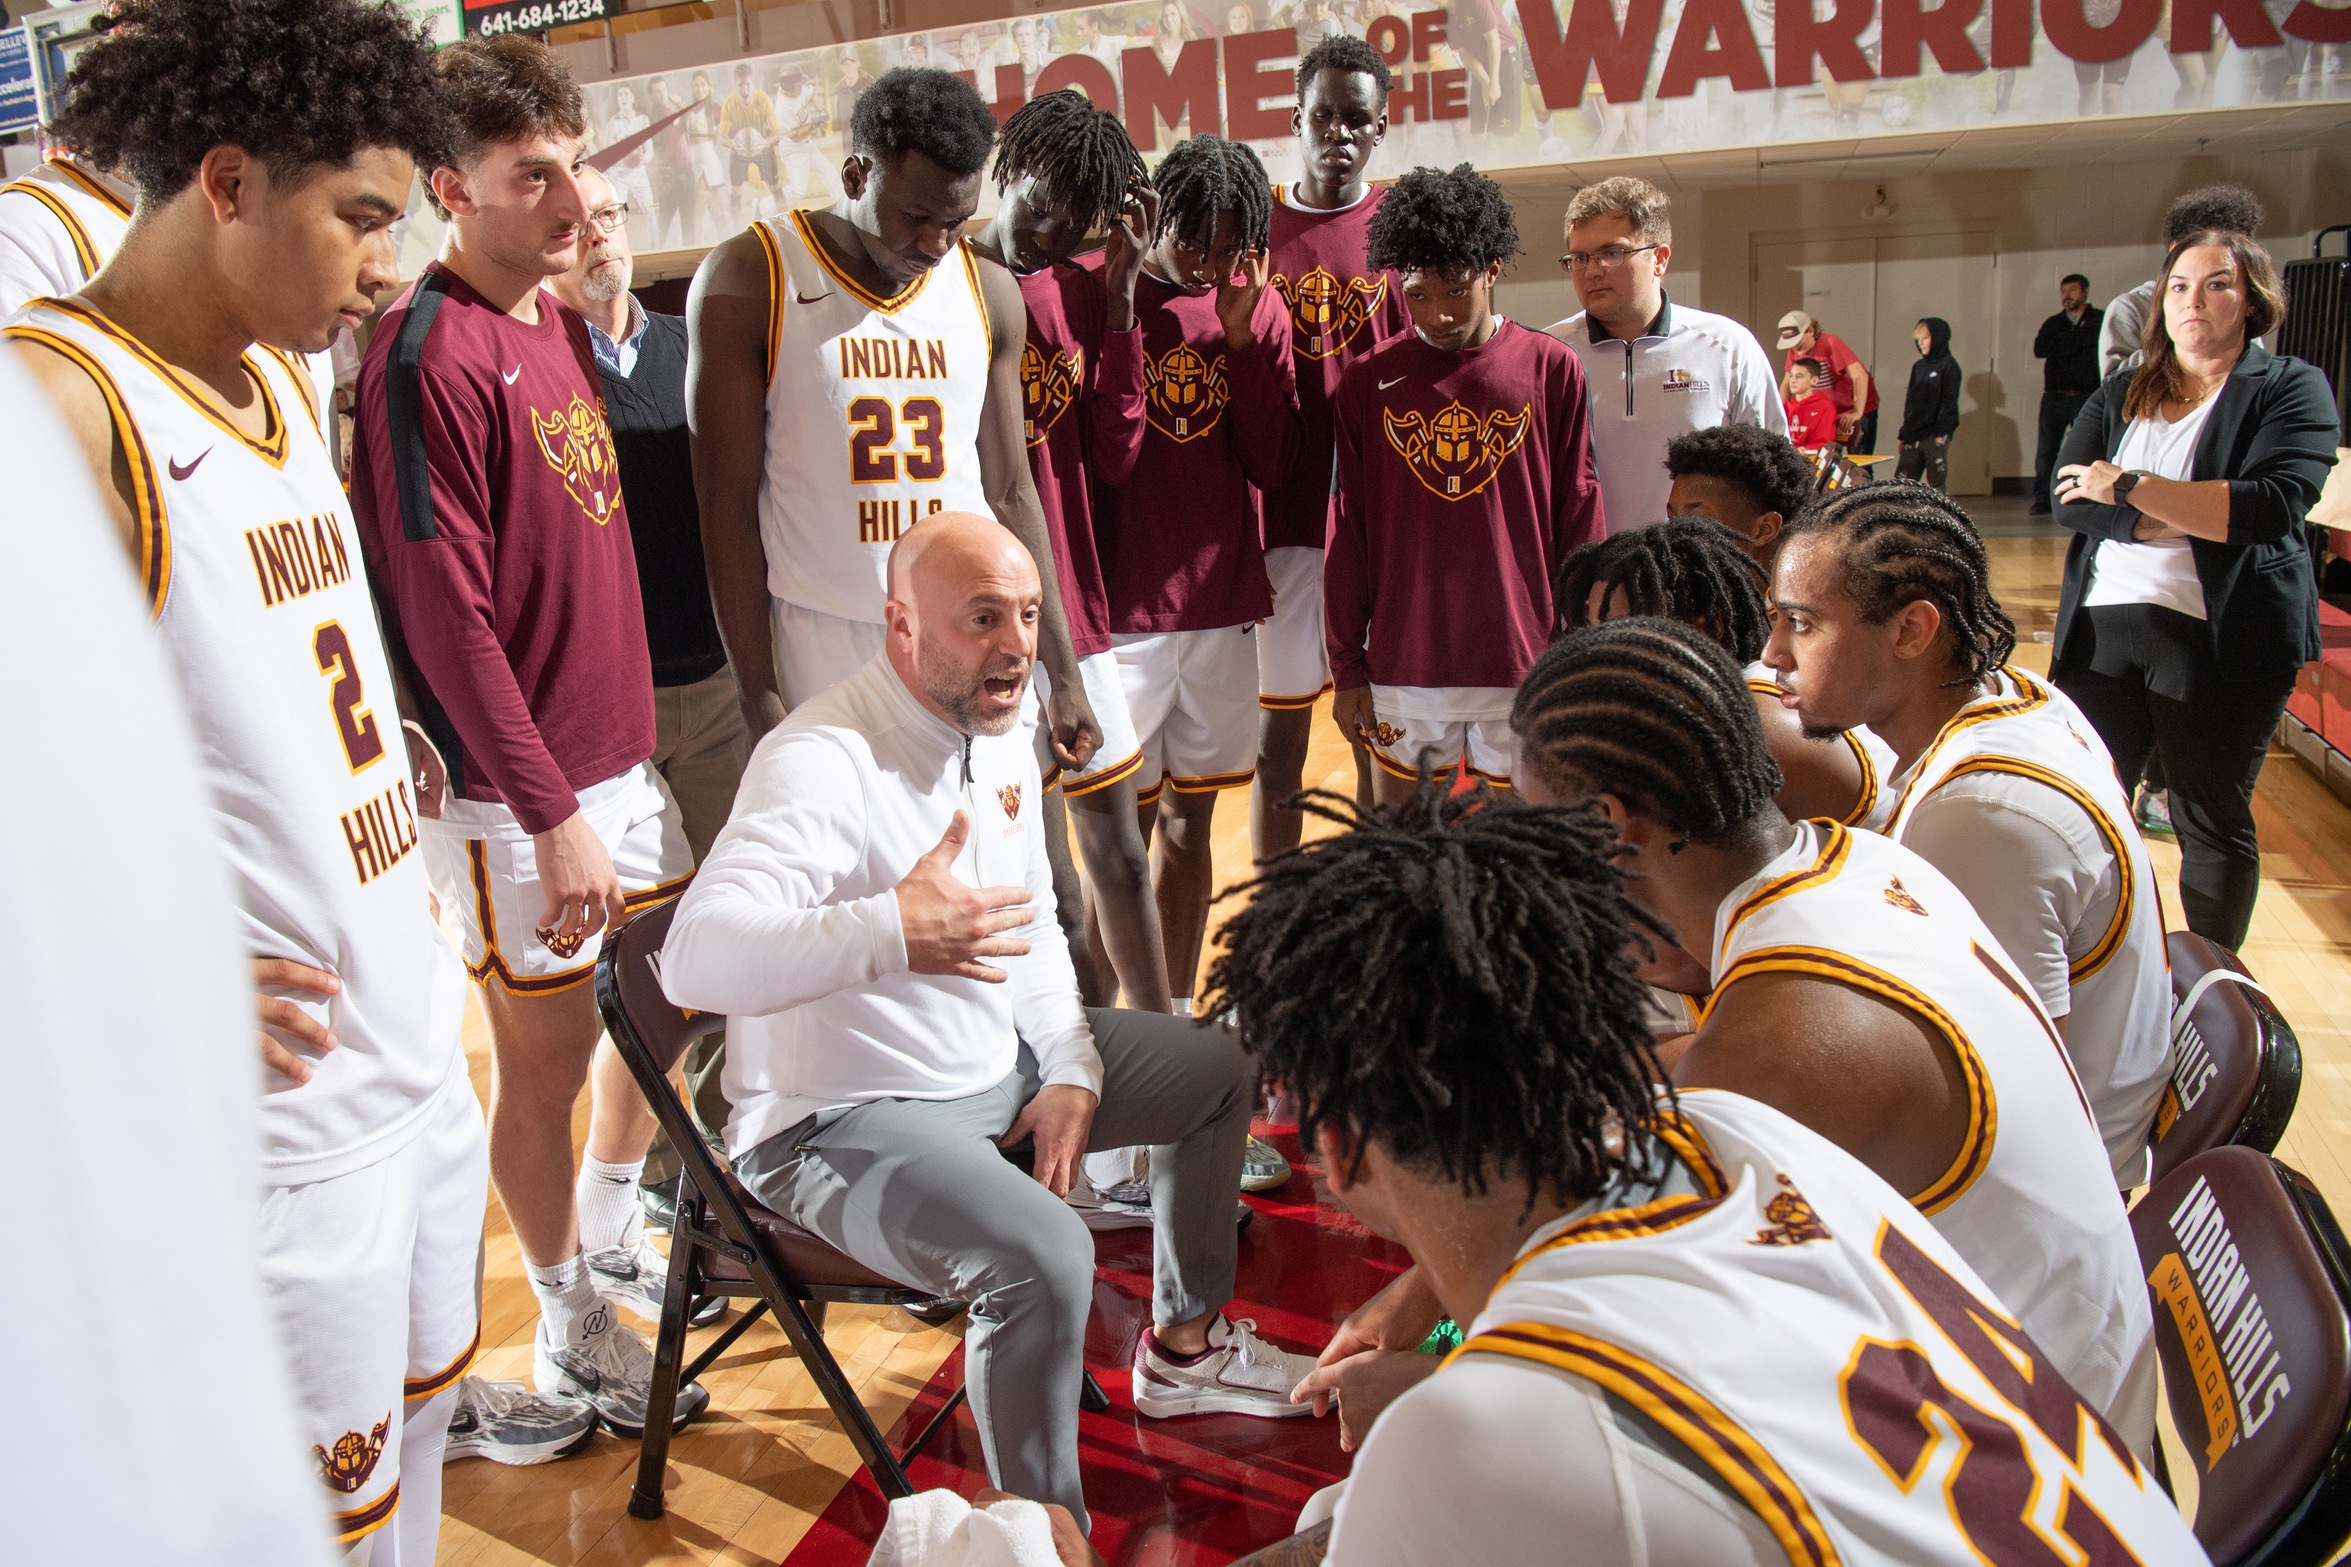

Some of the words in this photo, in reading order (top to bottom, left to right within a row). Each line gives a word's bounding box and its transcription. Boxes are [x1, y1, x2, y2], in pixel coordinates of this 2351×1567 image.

[481, 1, 604, 36] 641-684-1234
[1366, 9, 1447, 66] OF
[1387, 68, 1468, 125] HE
[839, 336, 947, 380] INDIAN
[847, 396, 947, 484] 23
[244, 511, 351, 608] INDIAN
[312, 618, 386, 776] 2
[339, 777, 418, 887] HILLS
[2173, 1020, 2218, 1112] HILLS
[2167, 1267, 2229, 1440] WARRIORS
[2168, 1174, 2250, 1334] INDIAN
[2221, 1293, 2291, 1439] HILLS
[1837, 1213, 2147, 1567] 24
